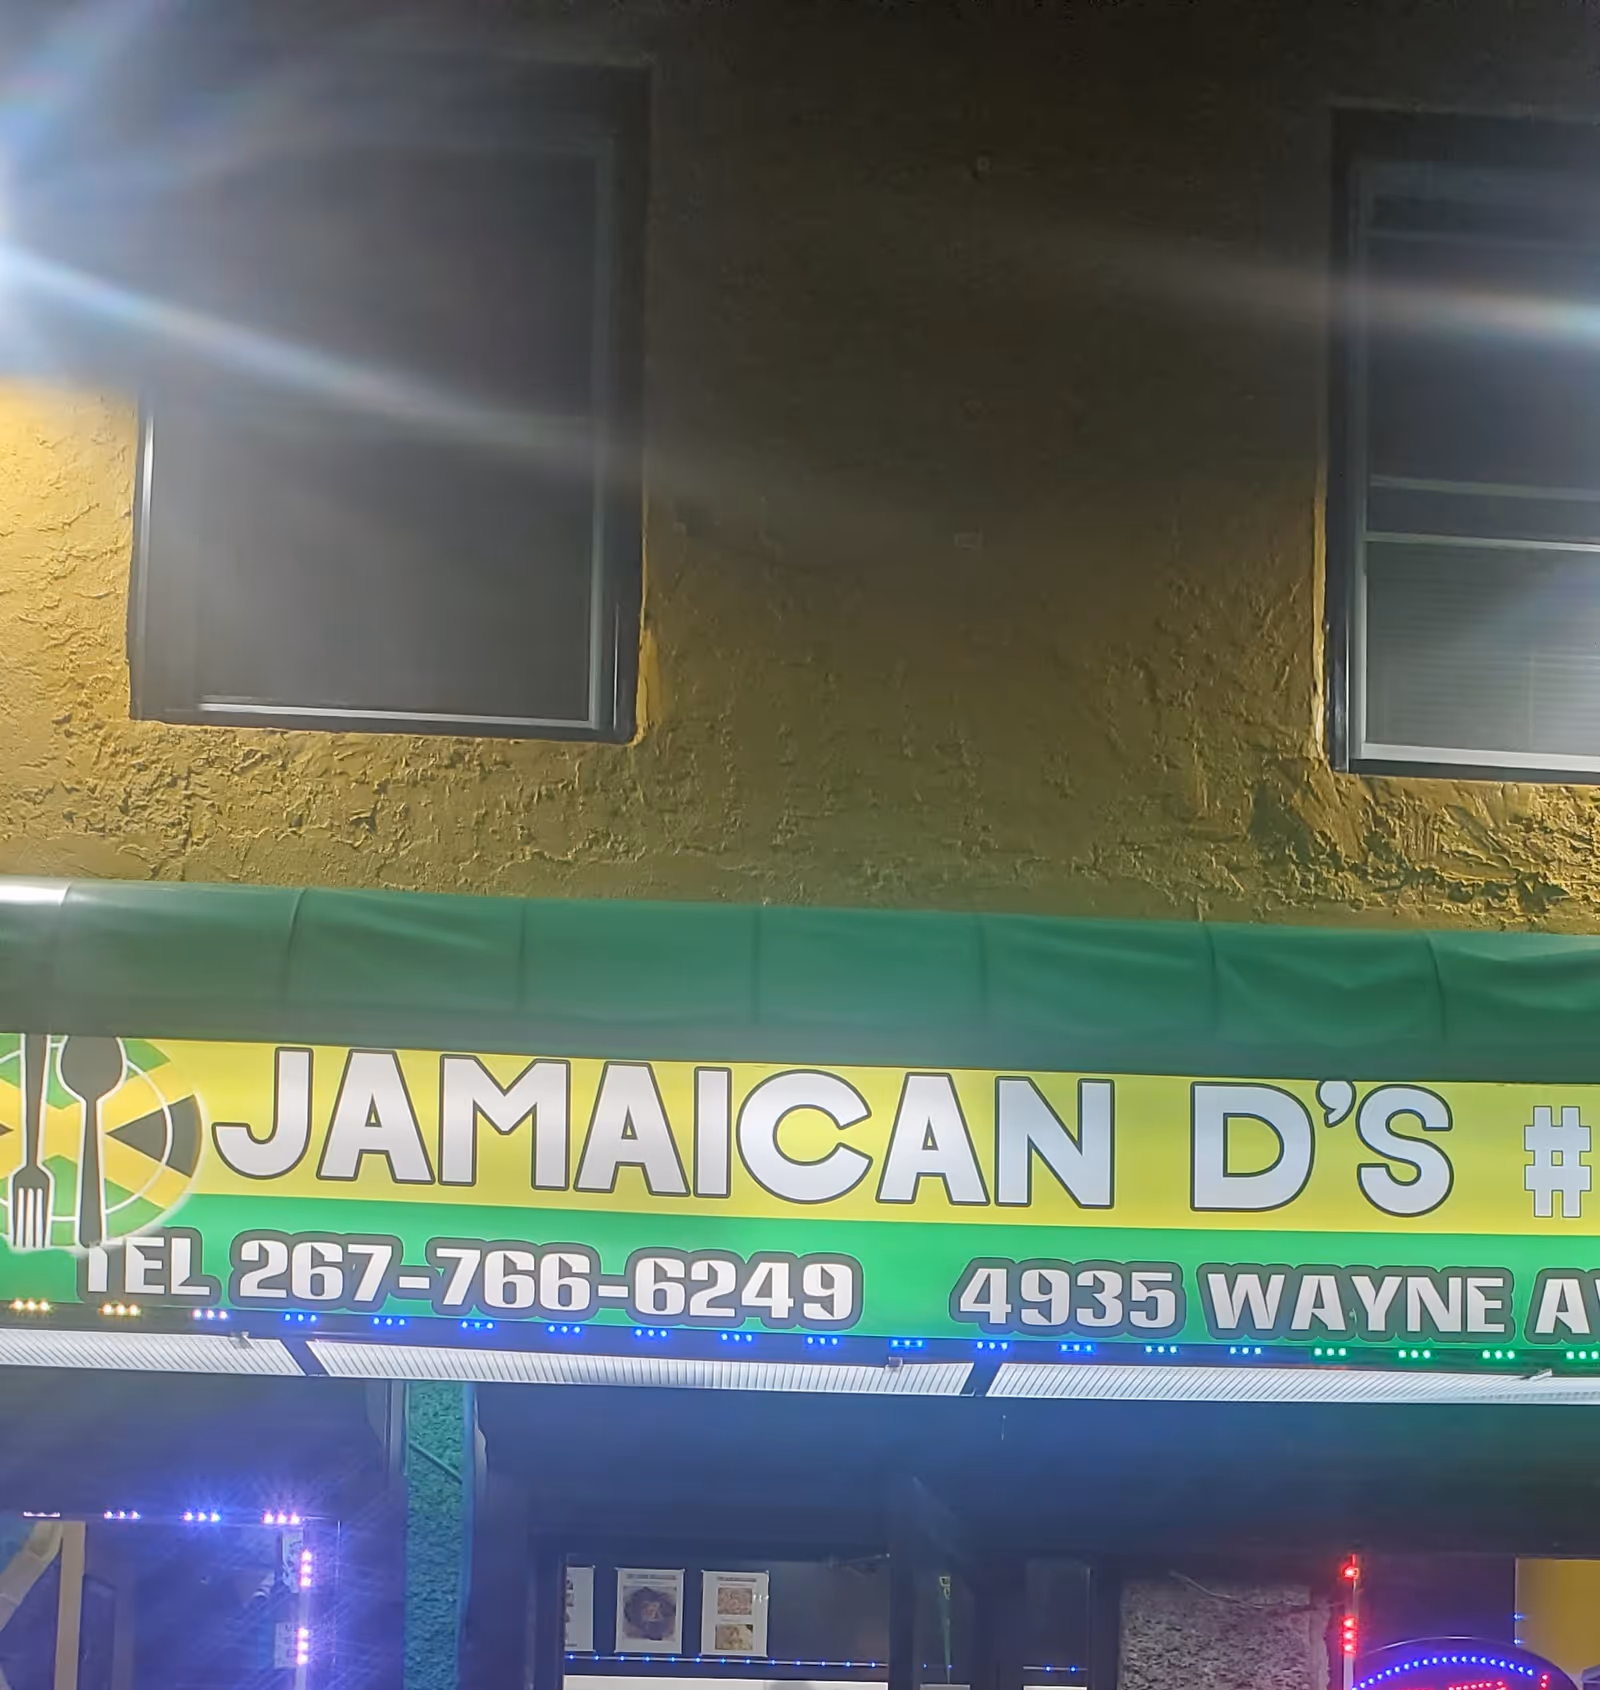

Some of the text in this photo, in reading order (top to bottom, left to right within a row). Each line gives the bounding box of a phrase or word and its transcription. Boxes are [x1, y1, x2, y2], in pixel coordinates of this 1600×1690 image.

[211, 1046, 1592, 1218] JAMAICAN D'S #
[85, 1236, 856, 1321] TEL 267-766-6249
[959, 1267, 1600, 1335] 4935 WAYNE A
